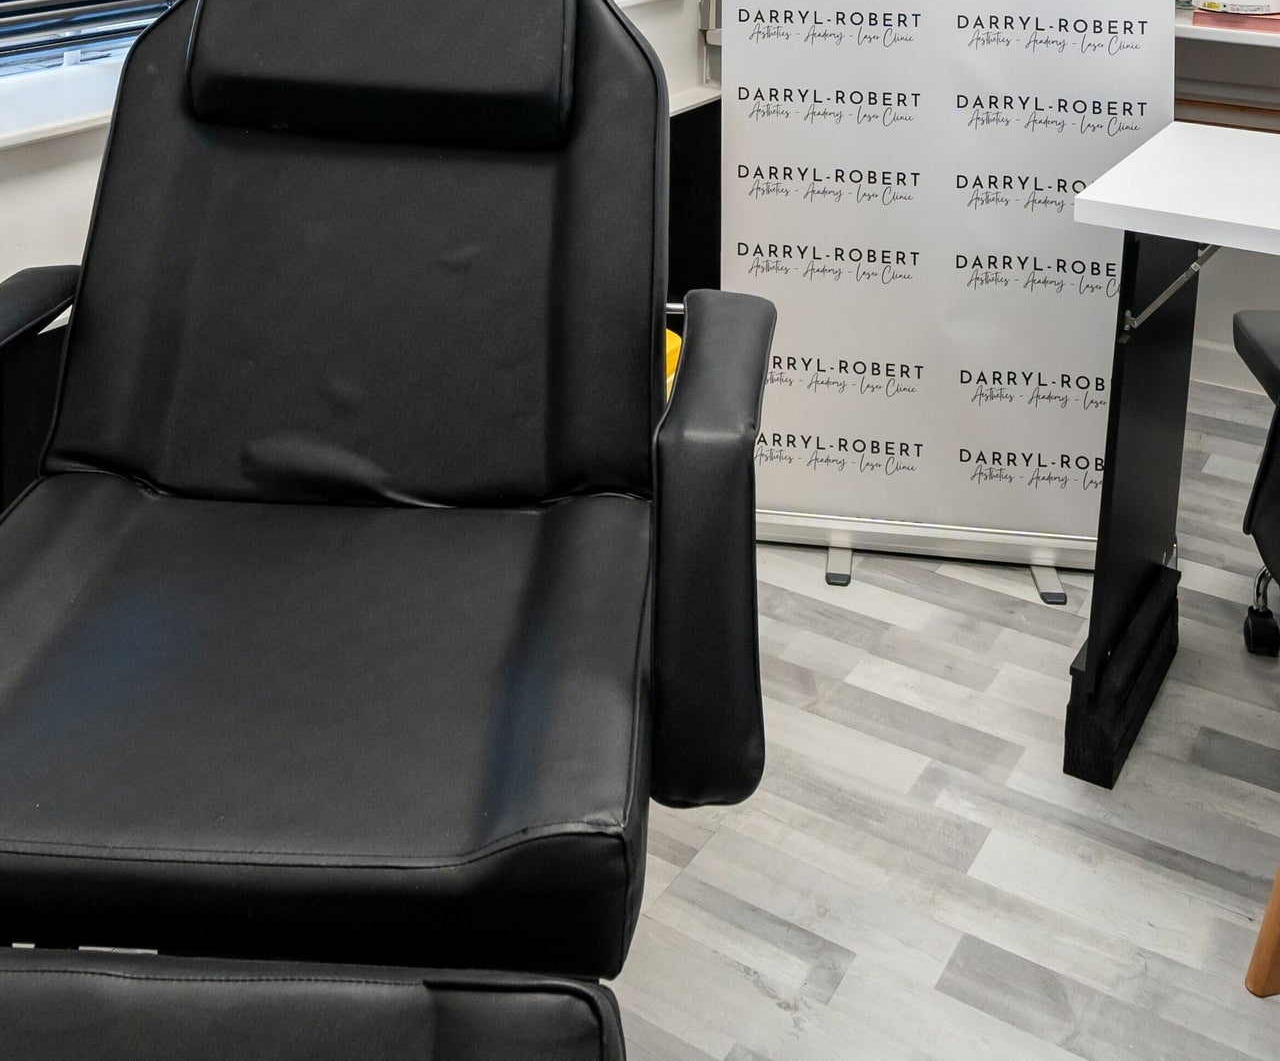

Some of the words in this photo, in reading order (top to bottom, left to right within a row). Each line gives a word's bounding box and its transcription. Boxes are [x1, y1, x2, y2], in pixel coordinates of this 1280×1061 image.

[738, 8, 921, 28] DARRYL-ROBERT
[957, 15, 1148, 35] DARRYL-ROBERT
[748, 24, 792, 43] Aesthetics
[803, 26, 845, 45] Academy
[857, 27, 882, 45] Laser
[882, 28, 914, 47] Clinic
[967, 30, 1012, 50] Aesthetics
[1024, 32, 1068, 53] Academy
[1080, 34, 1105, 53] Laser
[1107, 35, 1141, 55] Clinic
[738, 86, 921, 107] DARRYL-ROBERT
[956, 94, 1148, 117] DARRYL-ROBERT
[748, 102, 792, 121] Aesthetics
[803, 104, 845, 124] Academy
[856, 106, 880, 124] Laser
[882, 107, 914, 127] Clinic
[967, 110, 1012, 130] Aesthetics
[1023, 112, 1067, 133] Academy
[1080, 115, 1106, 134] Laser
[1106, 117, 1141, 136] Clinic
[738, 164, 921, 187] DARRYL-ROBERT
[956, 174, 1087, 194] DARRYL-RO
[747, 180, 790, 199] Aesthetics
[802, 183, 843, 202] Academy
[856, 185, 881, 203] Laser
[881, 186, 914, 205] Clinic
[966, 190, 1011, 210] Aesthetics
[1023, 192, 1067, 213] Academy
[737, 242, 920, 266] DARRYL-ROBERT
[956, 254, 1116, 277] DARRYL-ROBE
[747, 258, 791, 277] Aesthetics
[802, 261, 844, 281] Academy
[855, 263, 879, 282] Laser
[881, 265, 913, 284] Clinic
[966, 270, 1011, 290] Aesthetics
[1022, 272, 1066, 293] Academy
[1078, 276, 1103, 295] Laser
[772, 355, 924, 379] RRYL-ROBERT
[806, 373, 848, 393] Academy
[859, 376, 883, 394] Laser
[885, 378, 918, 397] Clinic
[960, 369, 1105, 391] DARRYL-ROB
[970, 385, 1015, 406] Aesthetics
[1027, 388, 1070, 408] Academy
[1083, 391, 1108, 410] Laser
[756, 432, 924, 458] ARRYL-ROBERT
[754, 446, 794, 466] Aesthetics
[806, 451, 848, 471] Academy
[859, 454, 884, 472] Laser
[884, 457, 917, 475] Clinic
[959, 448, 1105, 472] DARRYL-ROB
[969, 465, 1015, 484] Aesthetics
[1027, 469, 1070, 489] Academy
[1082, 471, 1103, 491] Lase
